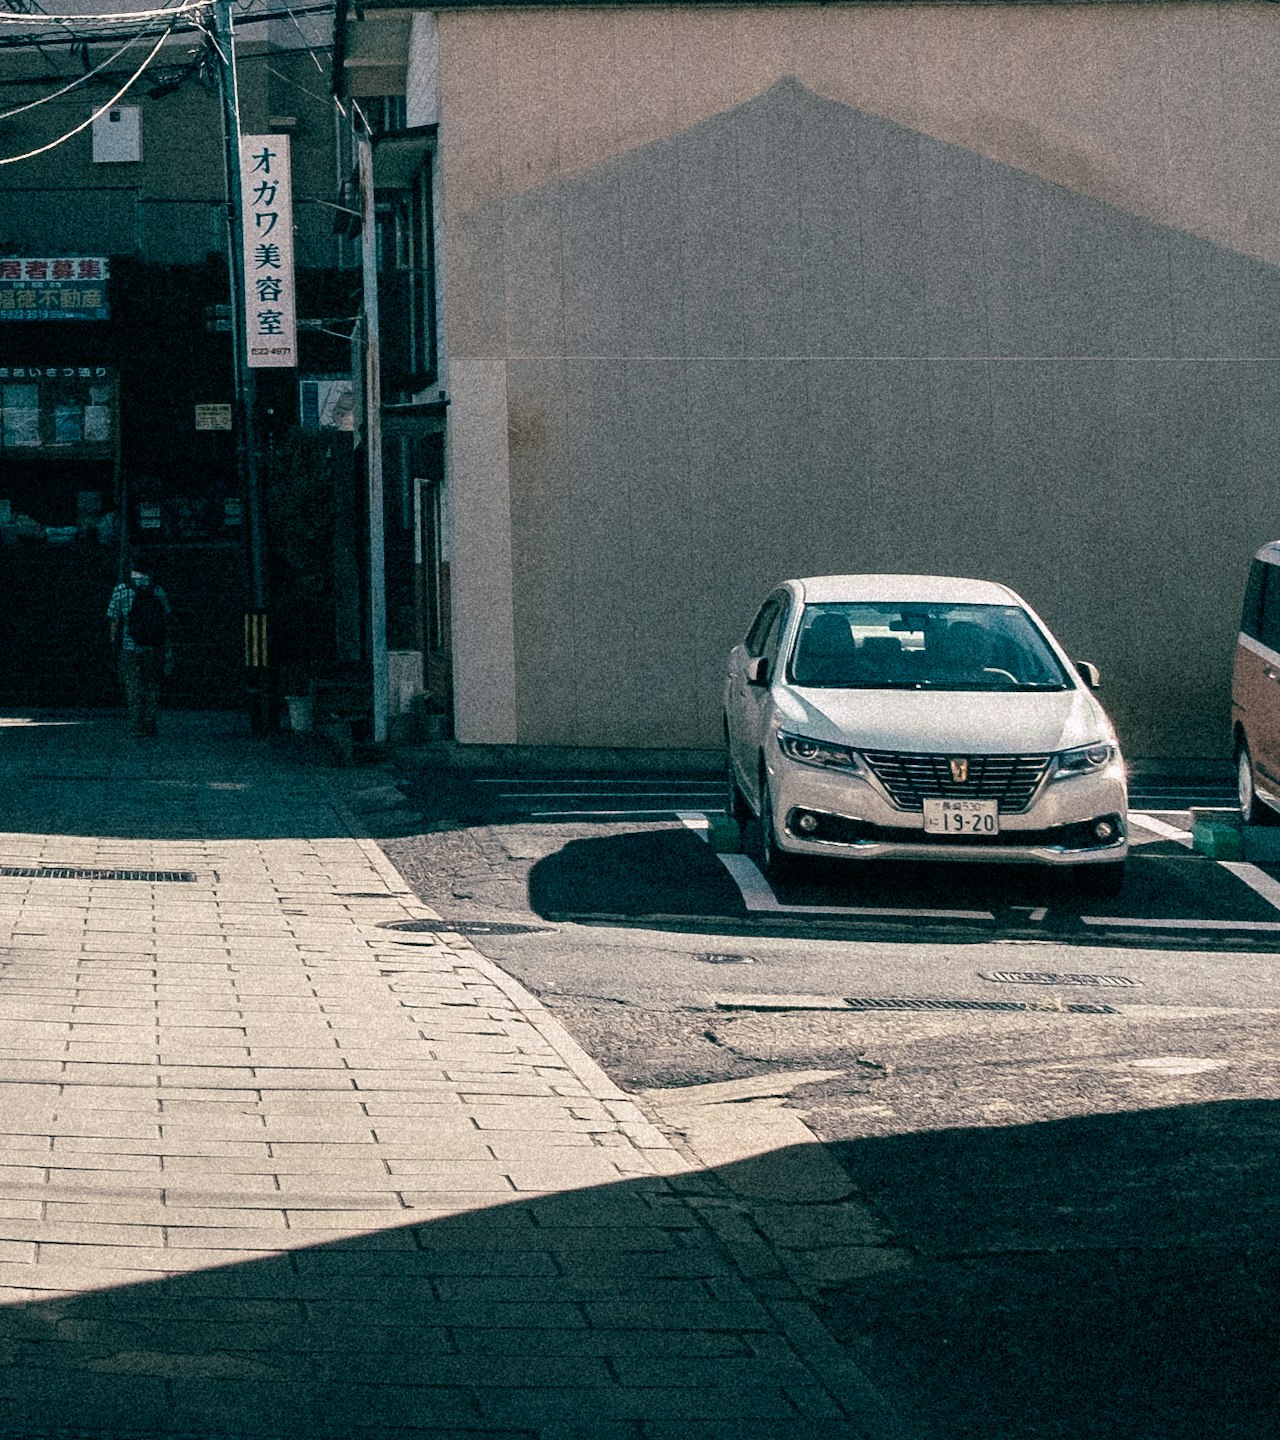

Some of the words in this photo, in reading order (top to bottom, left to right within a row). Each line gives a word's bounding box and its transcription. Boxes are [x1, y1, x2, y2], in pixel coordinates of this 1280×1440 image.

[251, 147, 285, 336] オガワ美容室
[943, 813, 995, 832] 19-20
